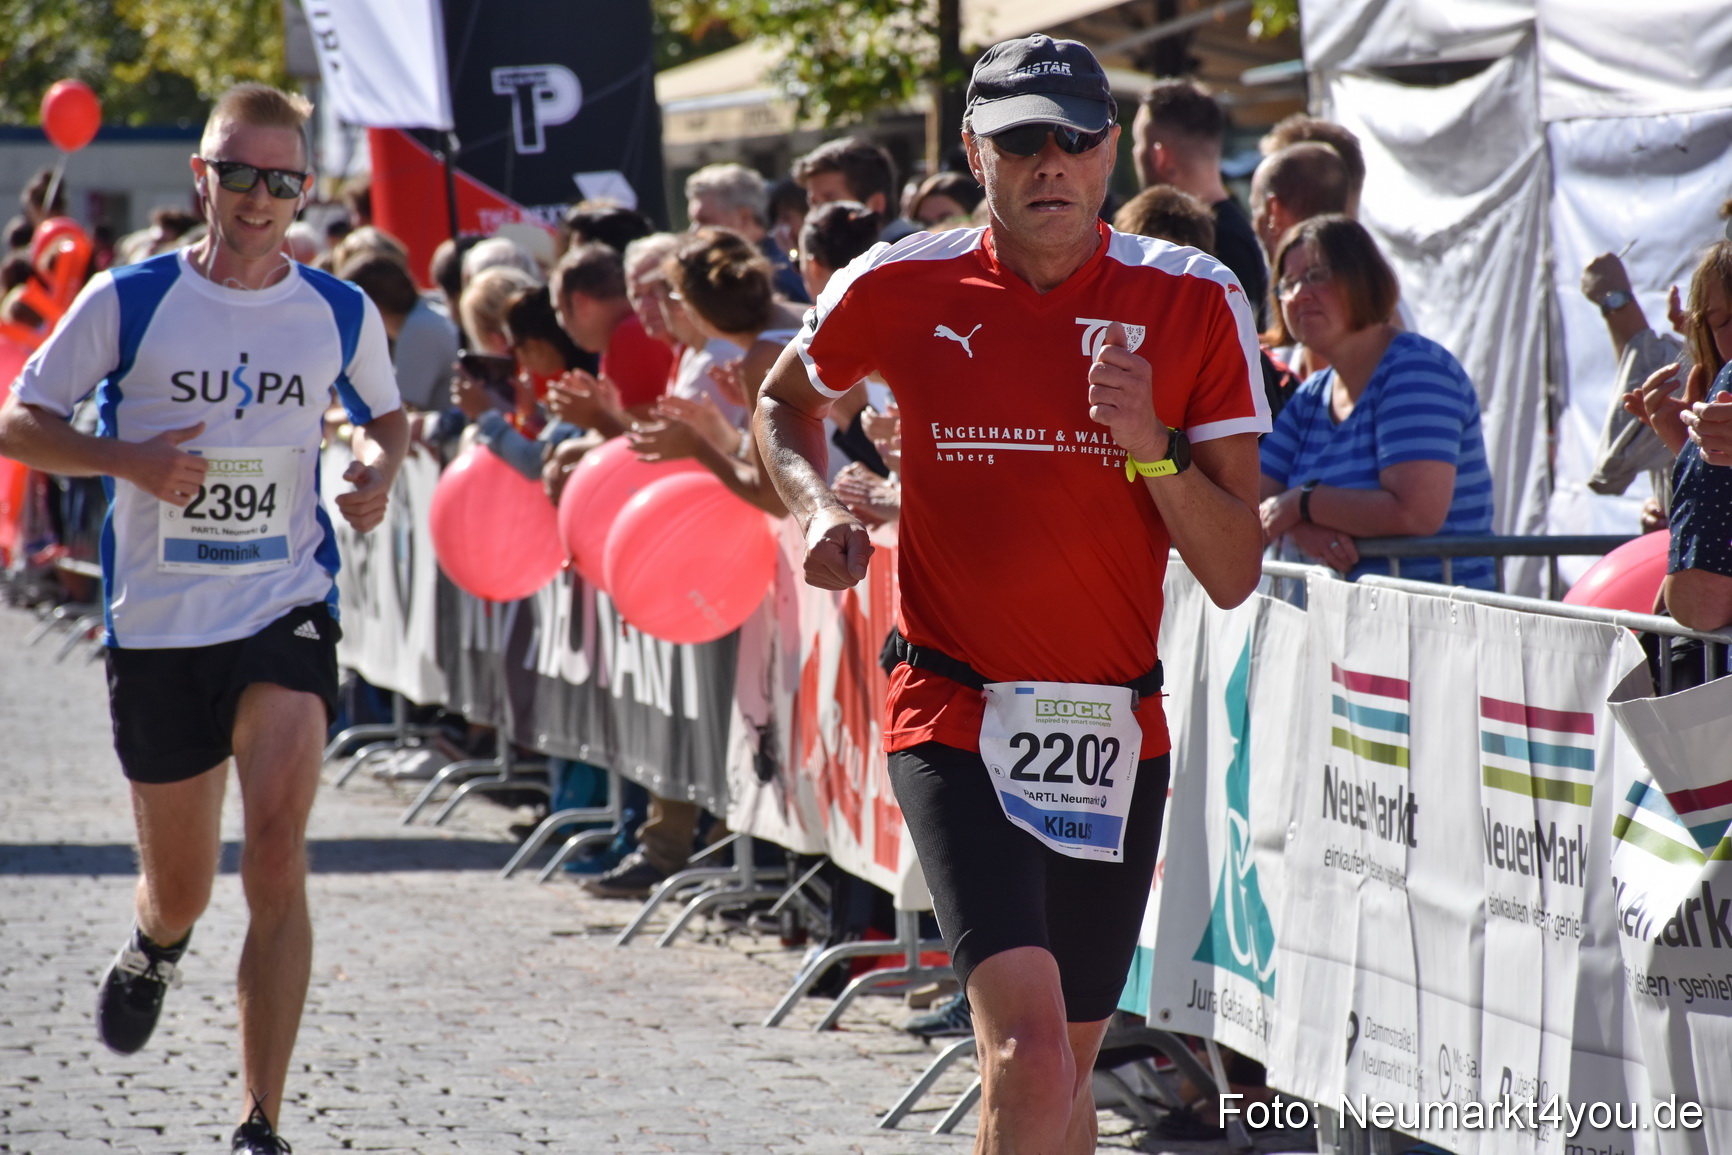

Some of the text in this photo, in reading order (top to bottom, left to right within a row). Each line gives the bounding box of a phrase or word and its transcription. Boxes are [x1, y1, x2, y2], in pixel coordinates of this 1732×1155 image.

[171, 352, 304, 420] SUSPA
[931, 423, 1118, 446] ENGELHARDT & WAL
[936, 452, 995, 465] Amberg
[1057, 445, 1127, 457] DAS HERRENH
[207, 459, 264, 473] BOCK
[183, 483, 277, 522] 2394
[191, 526, 258, 537] PARTL Neumarkt
[197, 544, 261, 561] Dominik
[1035, 699, 1112, 721] BOCK
[1035, 717, 1061, 725] inspired
[1009, 731, 1121, 788] 2202
[1023, 789, 1100, 806] PARTL Neumarkt
[1044, 815, 1093, 840] Klaus
[1481, 805, 1589, 888] NeuerMark
[1553, 911, 1580, 941] genie
[1634, 964, 1671, 996] leben
[1186, 979, 1218, 1014] Jura
[1364, 1016, 1412, 1053] Dammstraße
[1361, 1050, 1402, 1083] Neumarkt
